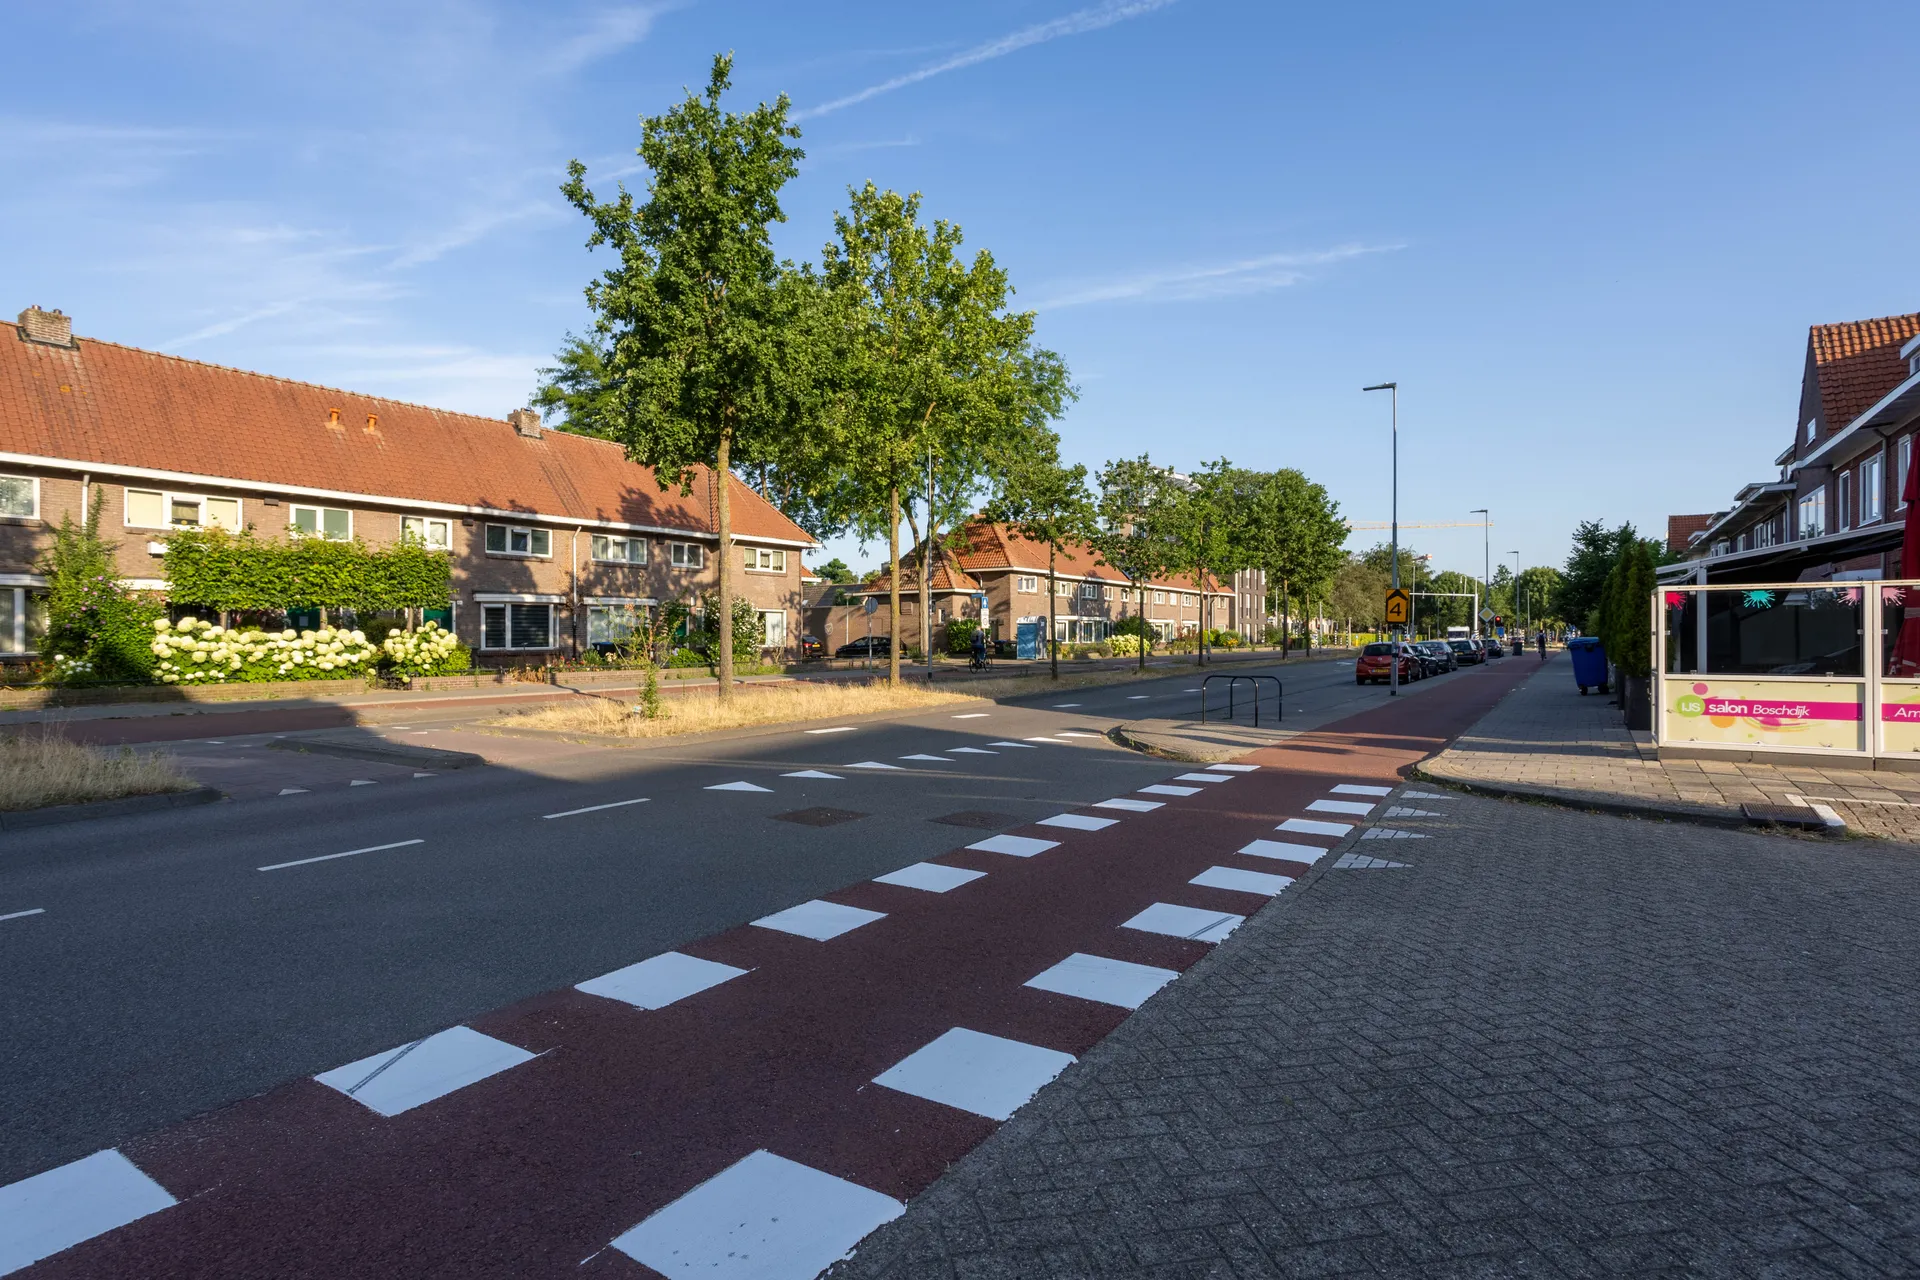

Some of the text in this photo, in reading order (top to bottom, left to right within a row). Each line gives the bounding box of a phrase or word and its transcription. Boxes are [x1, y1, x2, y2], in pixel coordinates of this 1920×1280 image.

[1389, 602, 1402, 617] 4
[1708, 700, 1748, 714] salon
[1752, 704, 1810, 719] Boschdijk
